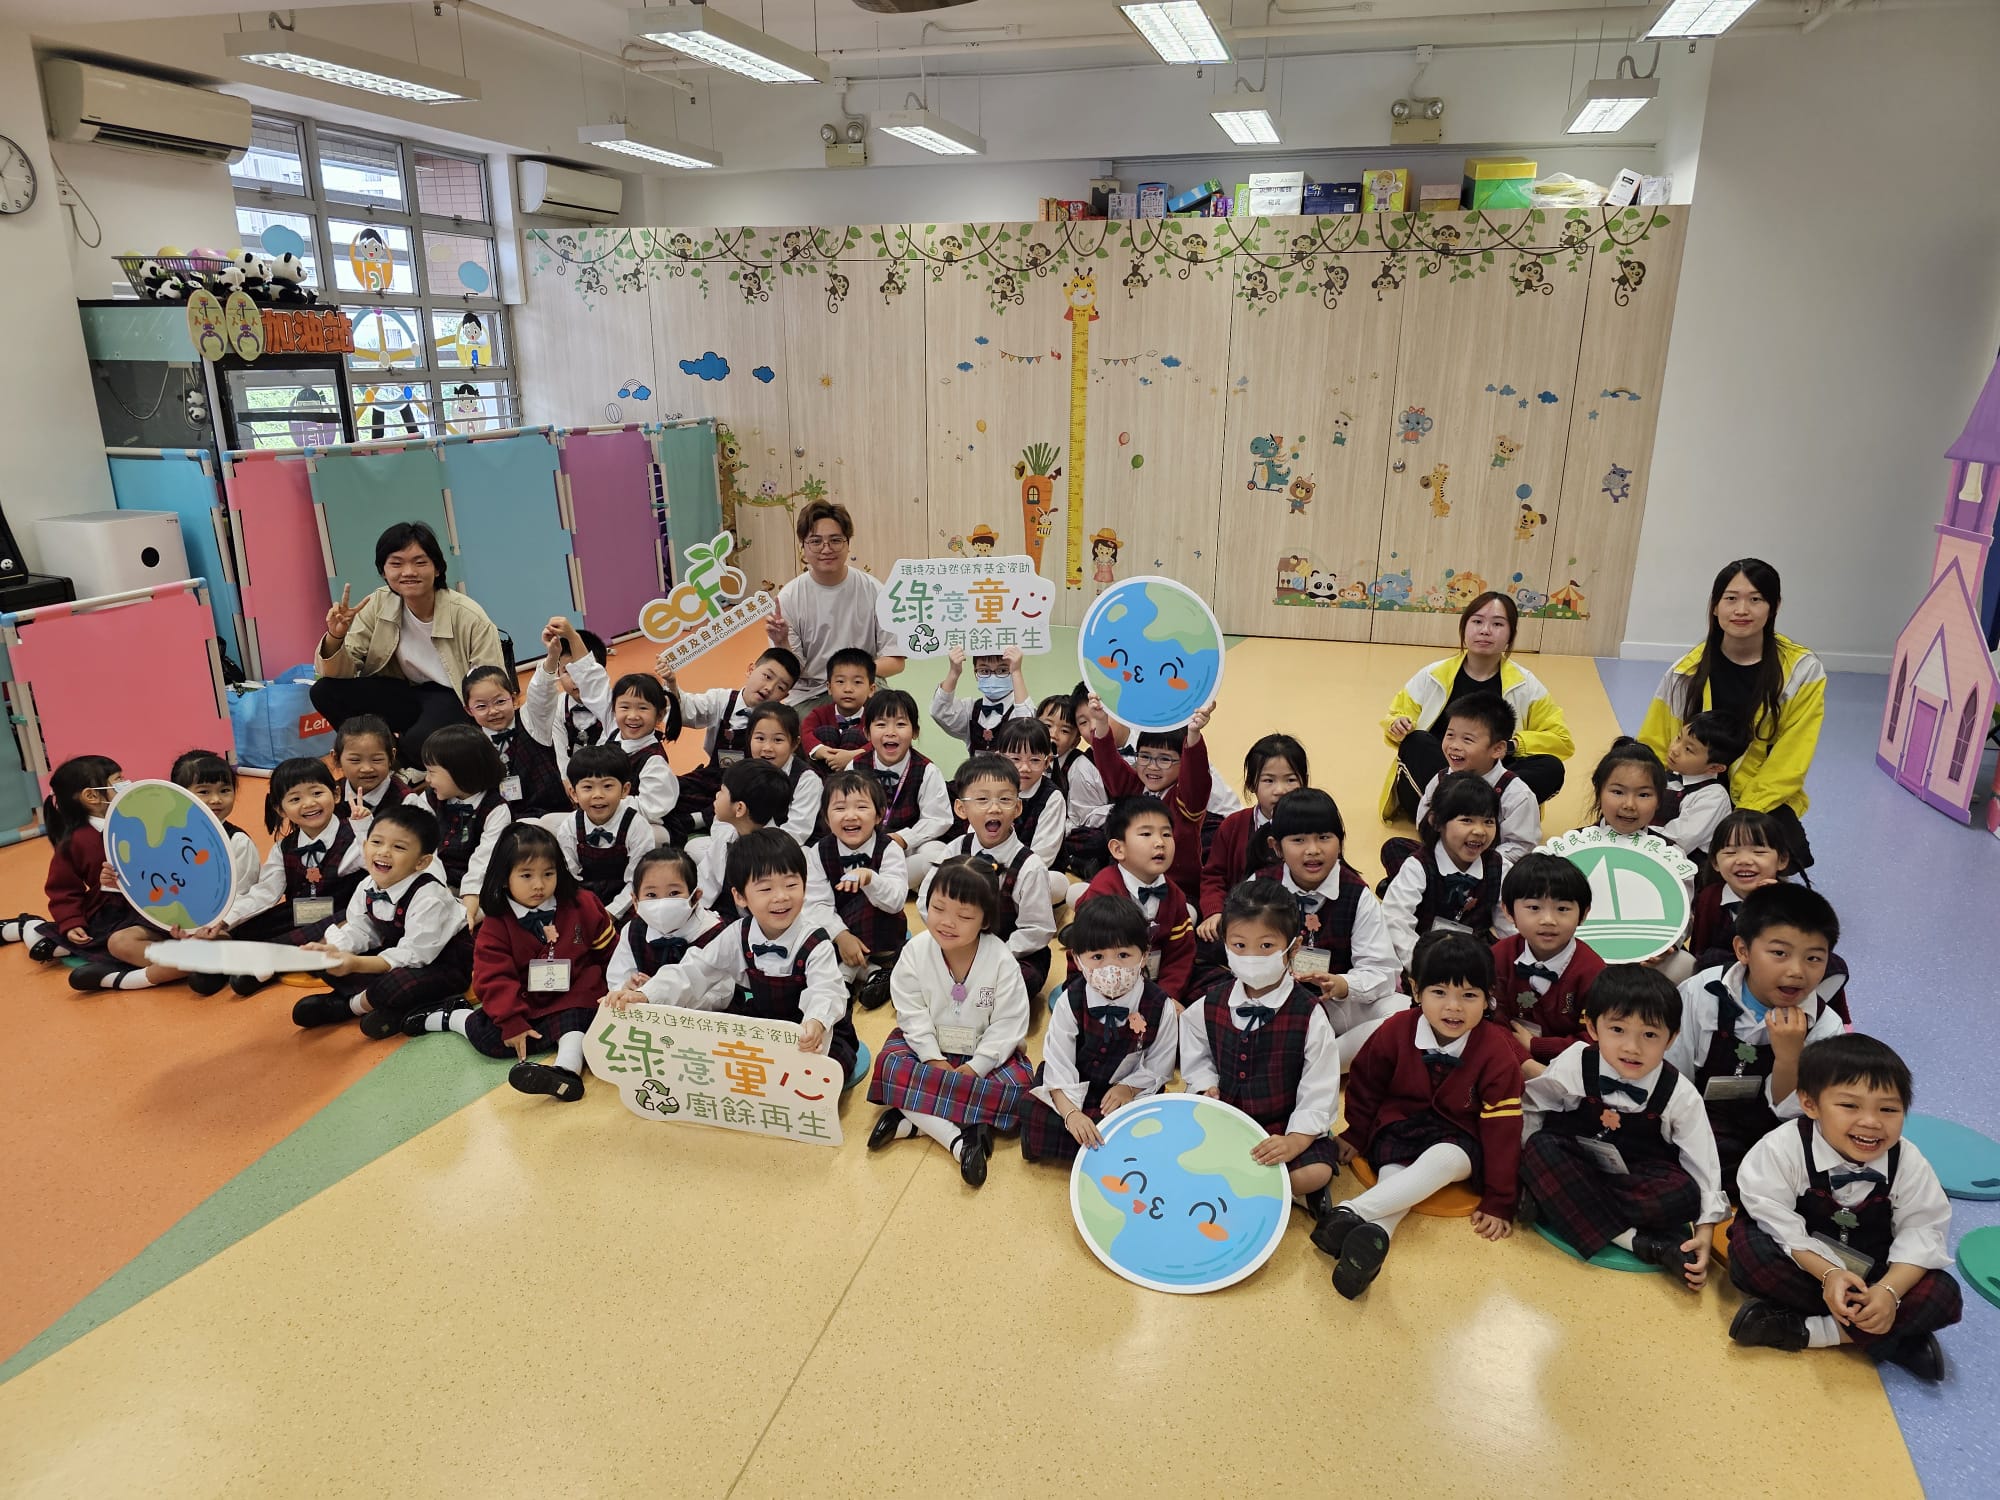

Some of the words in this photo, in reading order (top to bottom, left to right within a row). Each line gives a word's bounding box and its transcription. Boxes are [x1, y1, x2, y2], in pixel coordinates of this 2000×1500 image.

[23, 190, 31, 199] 4
[24, 175, 32, 184] 3
[1, 202, 9, 211] 6
[15, 199, 22, 209] 5
[262, 310, 355, 353] 加油站
[901, 563, 1031, 576] 環境及自然保育基金資助
[888, 577, 1048, 624] 綠意童心
[665, 594, 769, 663] 環境及自然保育基金
[670, 644, 709, 670] Environment
[708, 635, 720, 647] and
[719, 613, 758, 639] Conservation
[756, 602, 774, 617] Fund
[943, 626, 1044, 650] 廚餘再生
[1541, 829, 1693, 878] 居民協會有限公司
[611, 1007, 801, 1045] 環境及自然保育基金資助
[598, 1022, 831, 1100] 綠意童心
[686, 1091, 831, 1140] 廚餘再生
